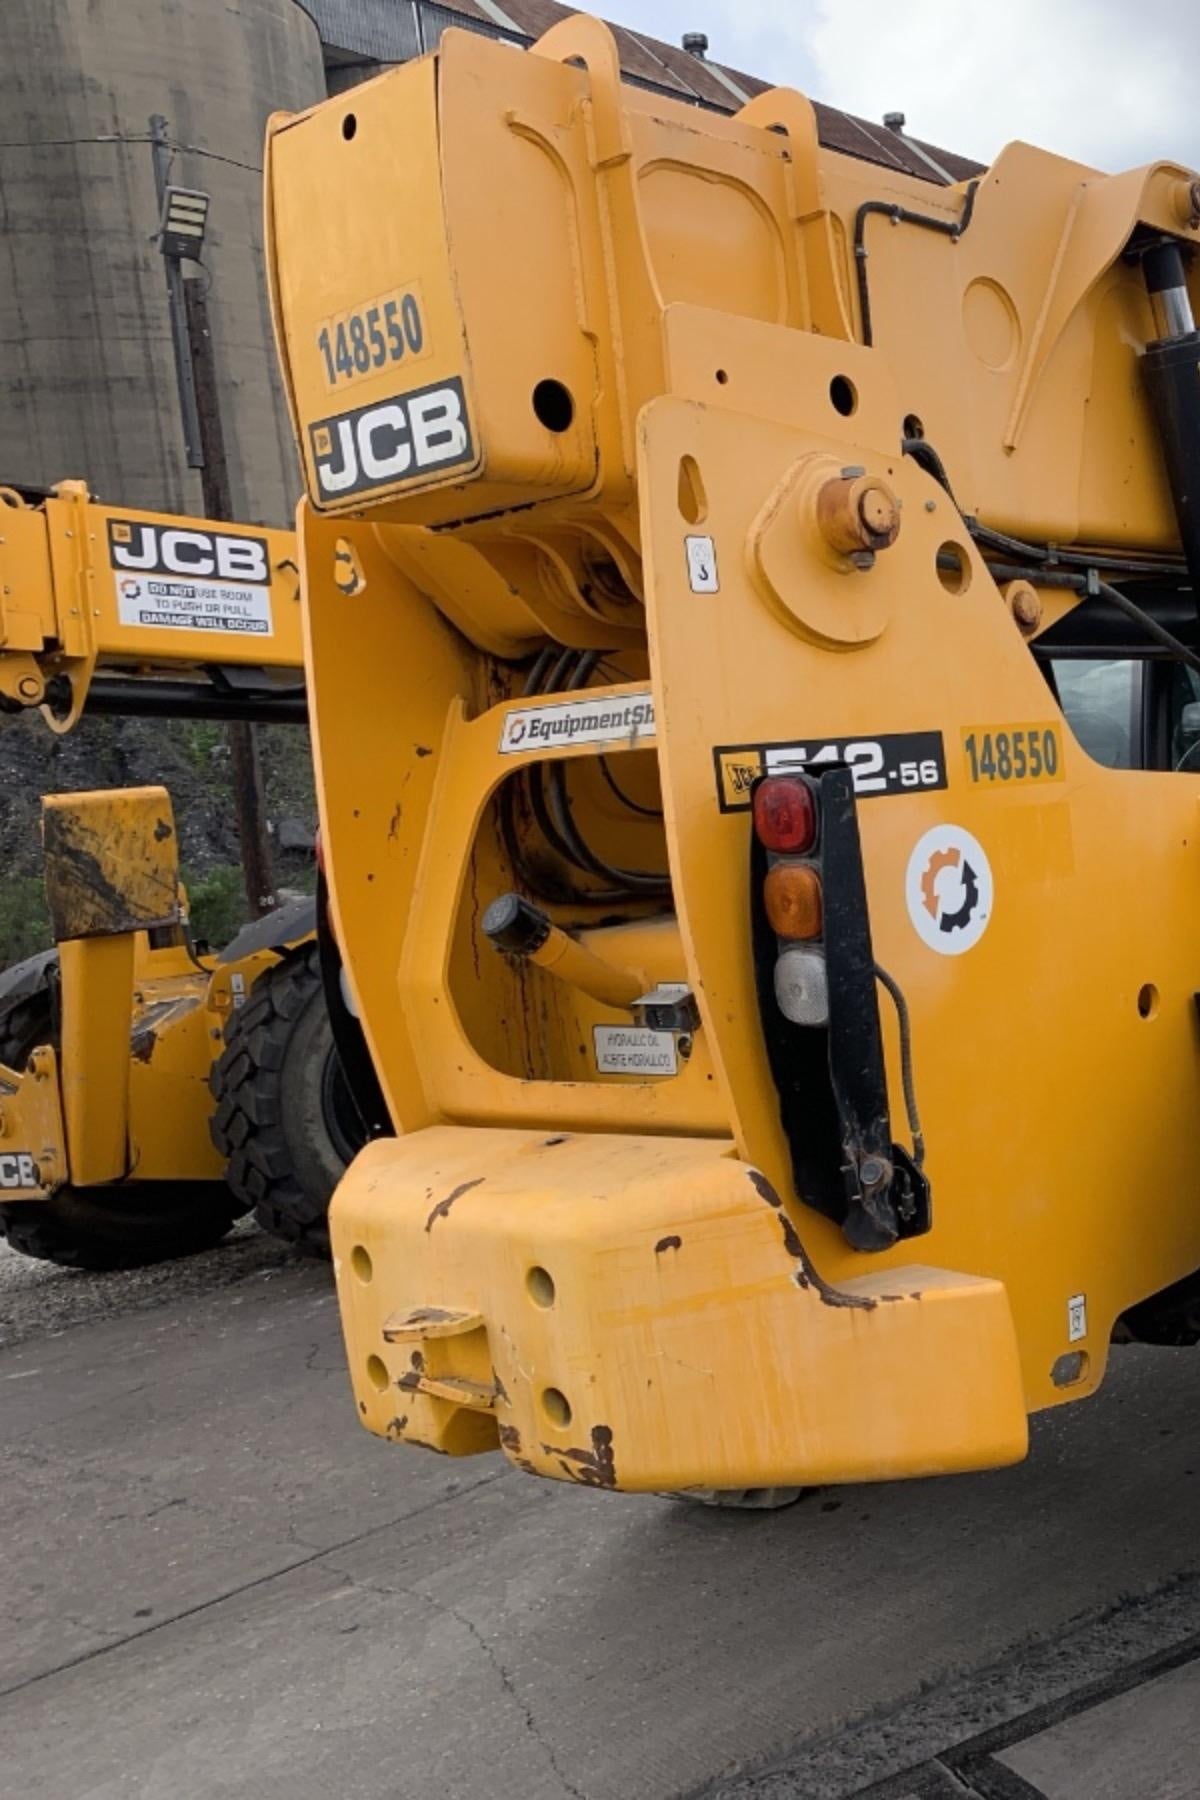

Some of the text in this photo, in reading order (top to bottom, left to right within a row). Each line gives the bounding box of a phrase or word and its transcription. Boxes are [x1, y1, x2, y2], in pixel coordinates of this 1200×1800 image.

[318, 293, 423, 385] 148550
[318, 387, 468, 492] JCB
[112, 526, 268, 582] JCB
[527, 704, 655, 741] EquipmentSh
[965, 729, 1058, 783] 148550
[0, 1155, 36, 1187] CB
